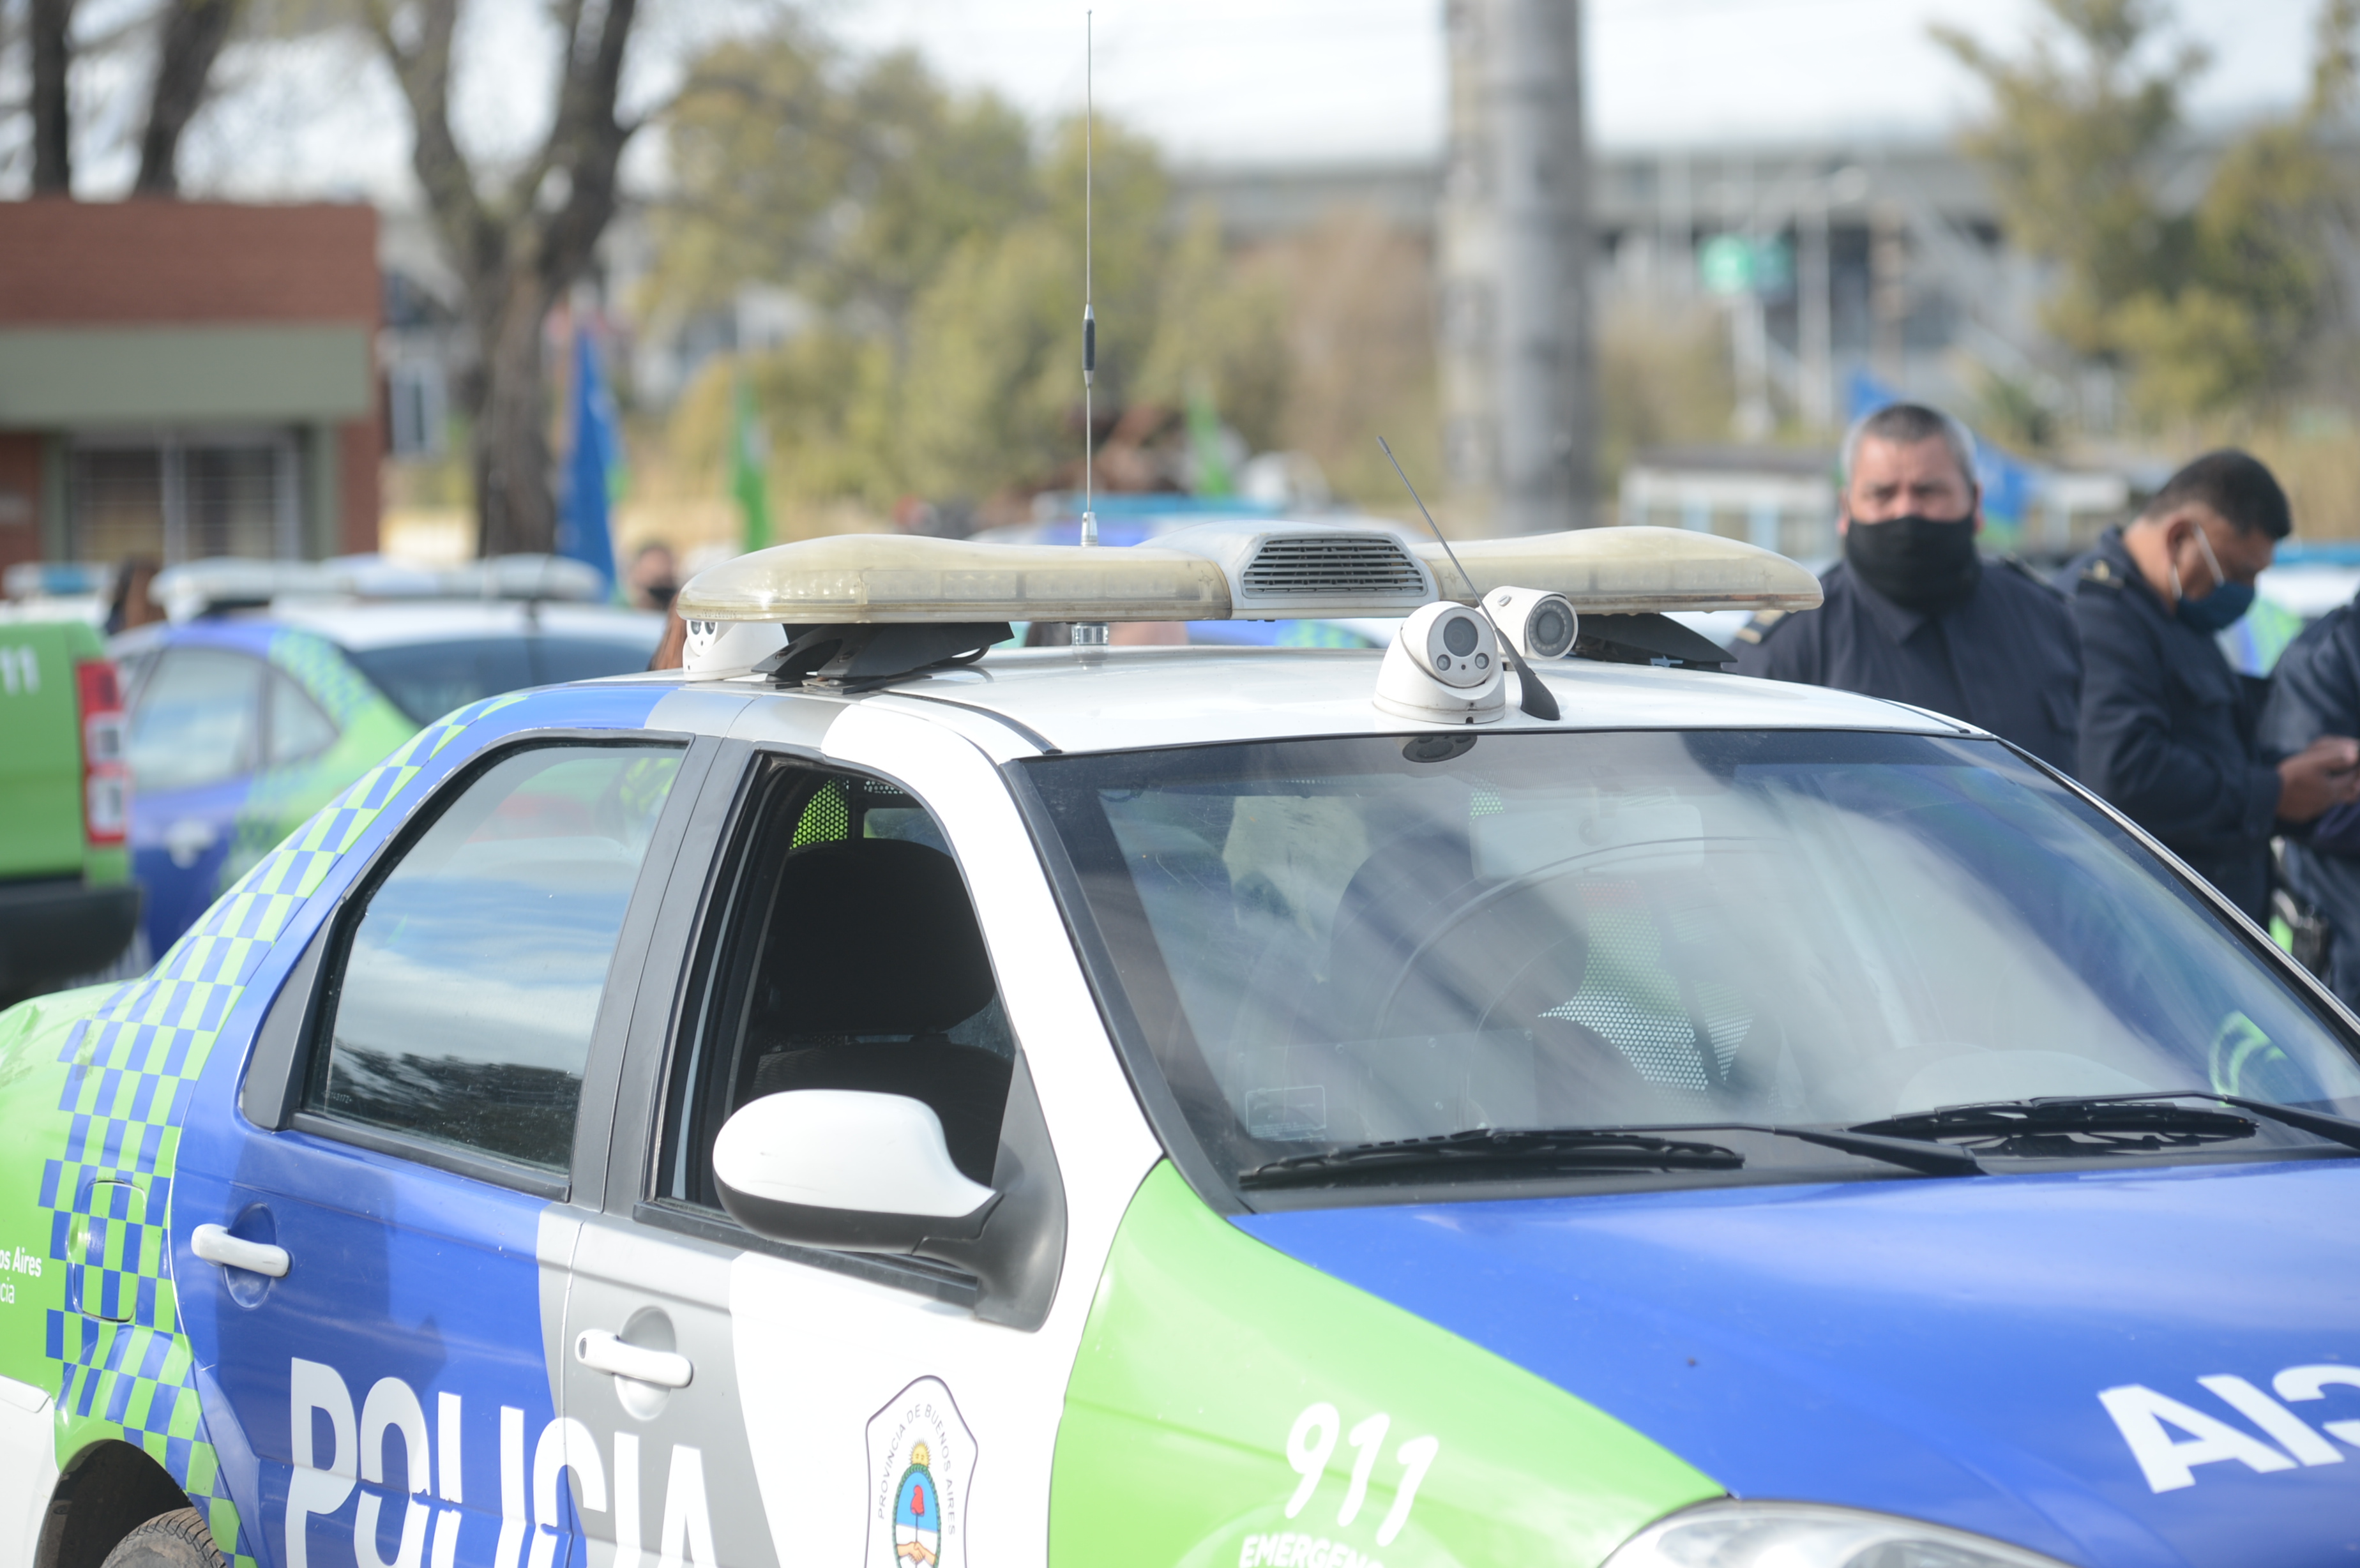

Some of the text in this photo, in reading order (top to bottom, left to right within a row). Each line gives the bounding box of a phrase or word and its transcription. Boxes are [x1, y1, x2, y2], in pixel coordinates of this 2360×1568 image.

[12, 1246, 42, 1278] Aires
[285, 1357, 718, 1568] POLICIA
[878, 1404, 955, 1535] PROVINCIA DE BUENOS AIRES
[1284, 1401, 1439, 1547] 911
[1239, 1532, 1384, 1568] EMERGEN
